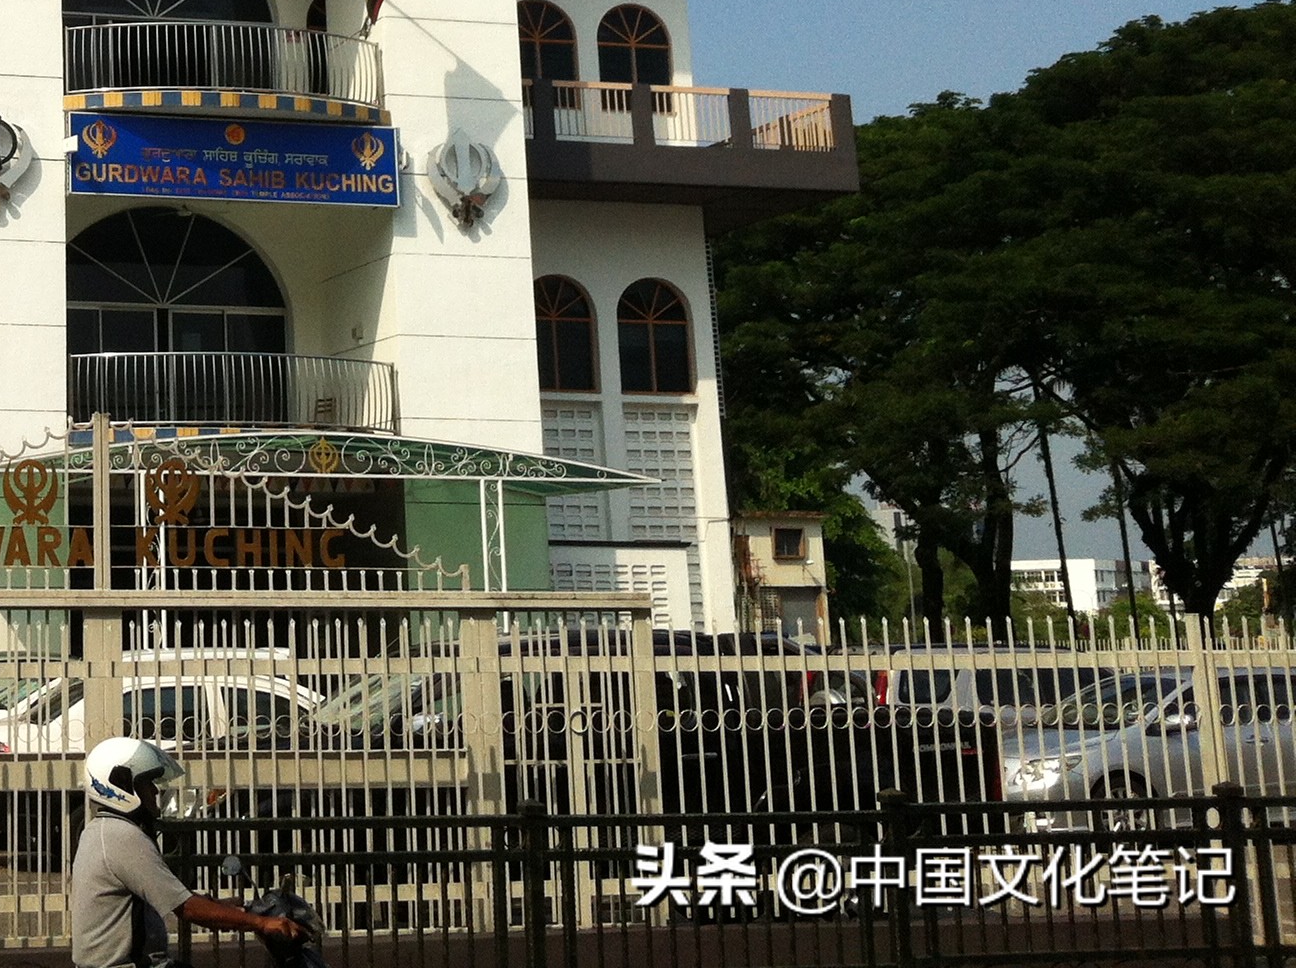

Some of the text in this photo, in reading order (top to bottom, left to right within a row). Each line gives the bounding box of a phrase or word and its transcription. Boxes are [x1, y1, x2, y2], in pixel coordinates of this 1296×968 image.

[75, 162, 394, 193] GURDWARA SAHIB KUCHING
[135, 528, 346, 568] KUCHING
